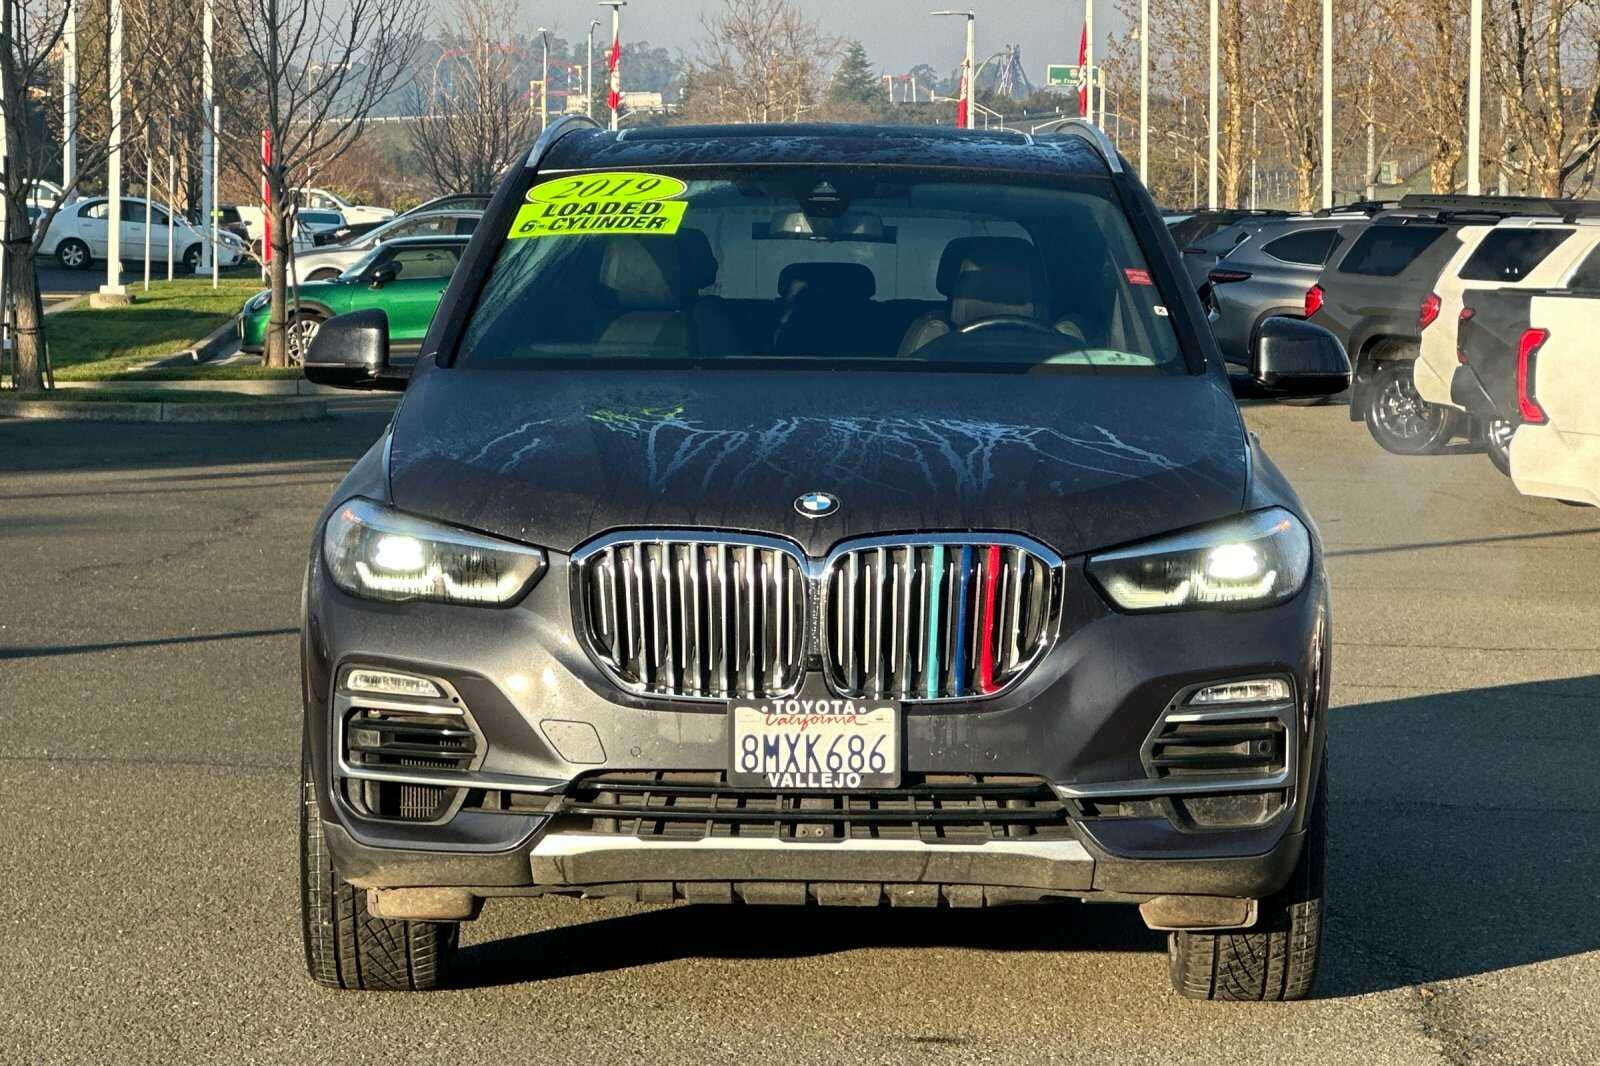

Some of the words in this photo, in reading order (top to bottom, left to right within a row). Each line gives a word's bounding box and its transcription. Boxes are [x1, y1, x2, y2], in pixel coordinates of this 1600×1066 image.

[550, 178, 661, 199] 2019
[541, 201, 663, 217] LOADED
[519, 216, 669, 233] 6-CYLINDER
[772, 700, 856, 715] TOYOTA
[741, 734, 887, 772] 8MXK686
[768, 773, 861, 788] VALLEJO
